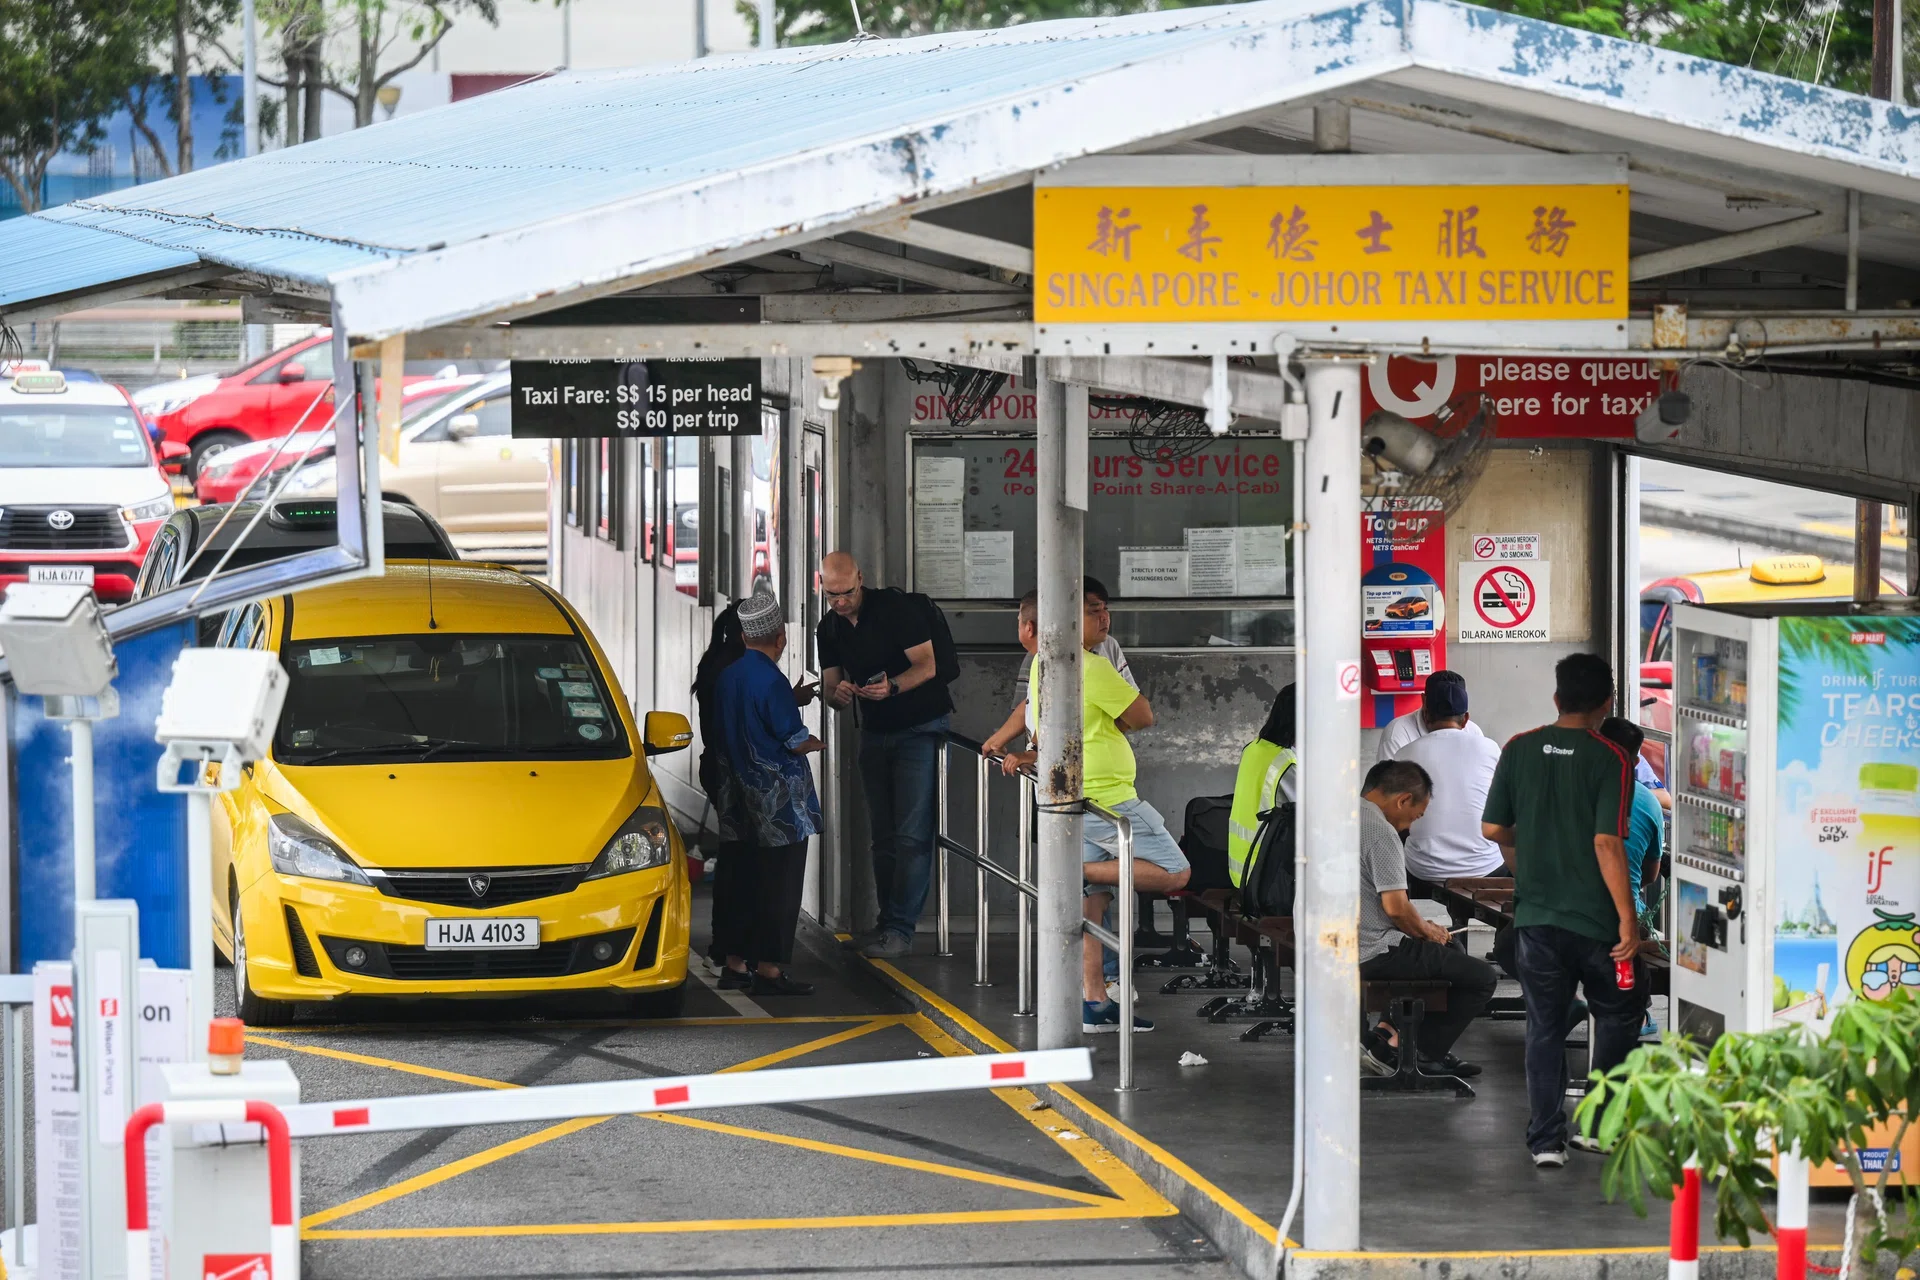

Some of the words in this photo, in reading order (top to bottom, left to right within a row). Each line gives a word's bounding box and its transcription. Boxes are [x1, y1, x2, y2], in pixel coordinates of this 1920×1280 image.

[1047, 271, 1239, 307] SINGAPORE
[1270, 270, 1382, 306] JOHOR
[1394, 270, 1467, 304] TAXI
[1478, 269, 1615, 304] SERVICE
[1479, 358, 1570, 387] please
[521, 387, 558, 404] Taxi
[564, 386, 610, 404] Fare:
[616, 384, 639, 405] S$
[645, 385, 667, 403] 15
[672, 387, 702, 406] per
[707, 384, 752, 402] head
[1552, 391, 1589, 416] for
[914, 394, 1038, 421] SINGAPOR
[616, 410, 640, 431] S$
[645, 411, 667, 429] 60
[672, 413, 702, 432] per
[707, 406, 739, 431] trip
[1003, 448, 1037, 478] 24
[1155, 447, 1280, 478] Service
[1093, 482, 1143, 496] Point
[1150, 481, 1280, 496] Share-A-Cab)
[1389, 544, 1419, 552] CashCard
[1495, 536, 1516, 544] DILARANG
[1509, 551, 1533, 559] SMOKING
[38, 570, 58, 580] HJA
[61, 570, 84, 580] 6717
[1461, 631, 1503, 639] DILARANG
[1505, 630, 1547, 639] MEROKOK
[1851, 634, 1865, 642] POP
[1866, 634, 1884, 642] MART
[1822, 675, 1868, 687] DRINK
[1890, 676, 1920, 687] TUR
[1823, 825, 1842, 834] cry
[1867, 846, 1894, 894] if
[439, 924, 475, 943] HJA
[482, 923, 525, 943] 4103
[104, 1020, 115, 1055] Wilson
[1863, 1160, 1898, 1169] THAILD
